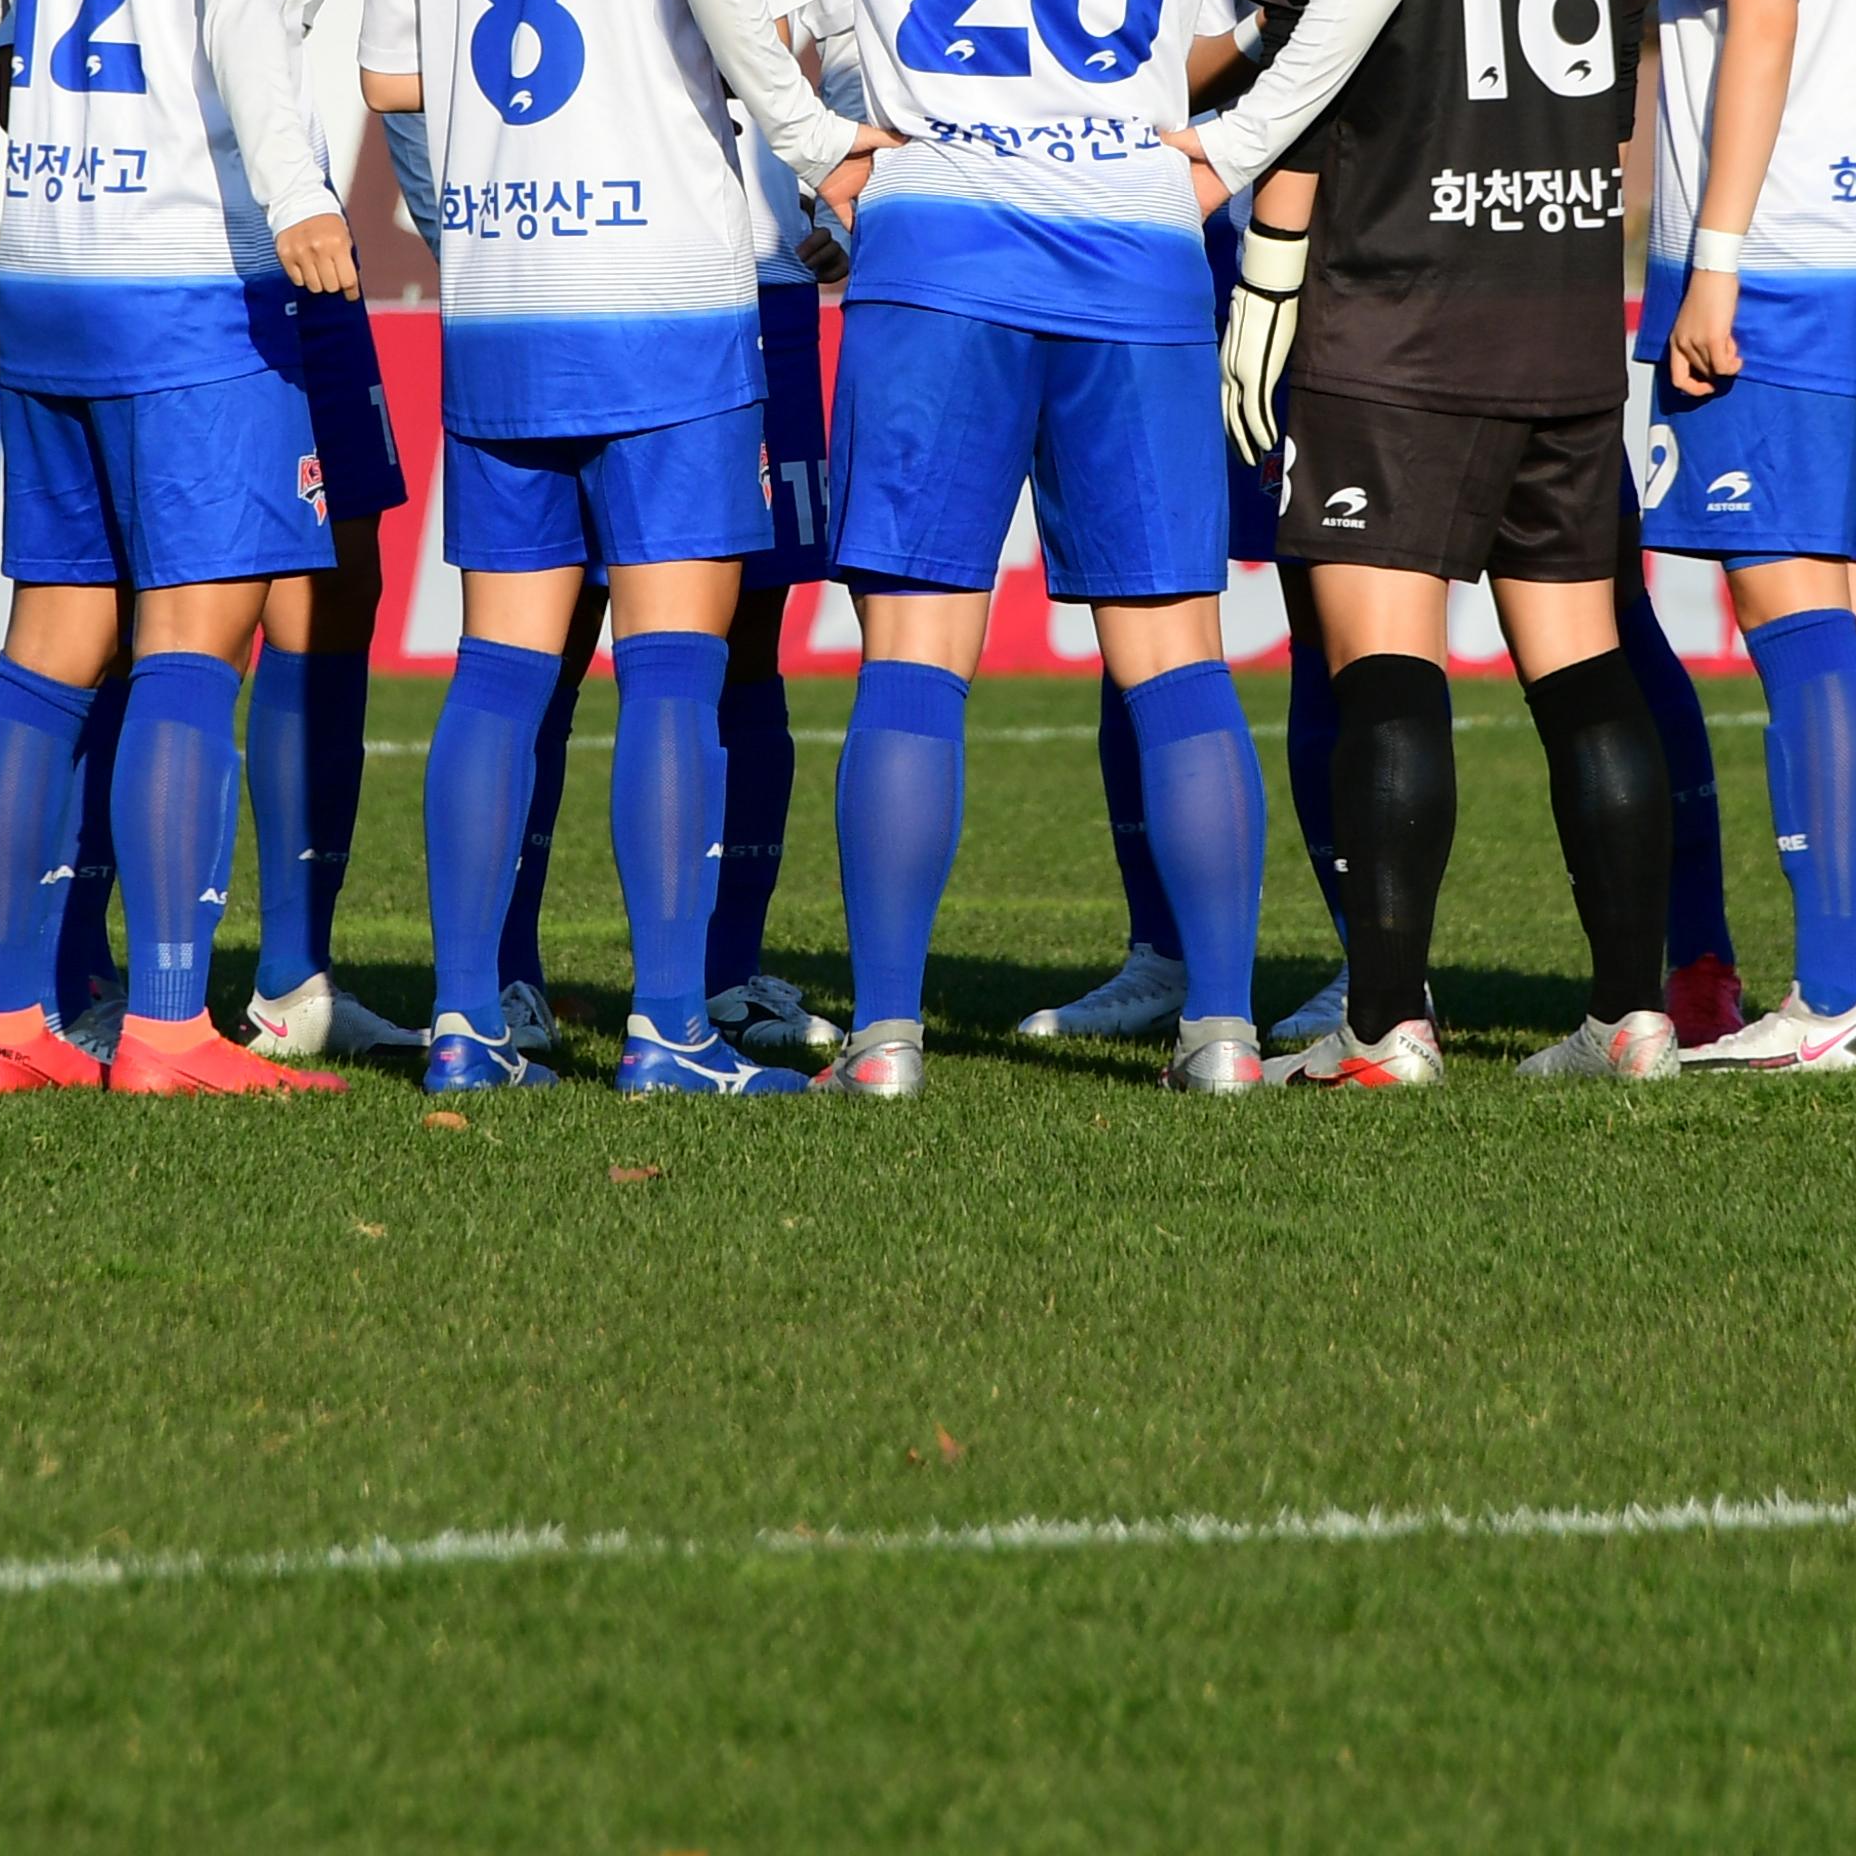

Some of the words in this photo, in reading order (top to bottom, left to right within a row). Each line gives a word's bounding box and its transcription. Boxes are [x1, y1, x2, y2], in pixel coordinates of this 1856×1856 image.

[6, 138, 150, 204] 천정산고
[441, 179, 649, 240] 화천정산고
[1321, 517, 1366, 530] ASTORE
